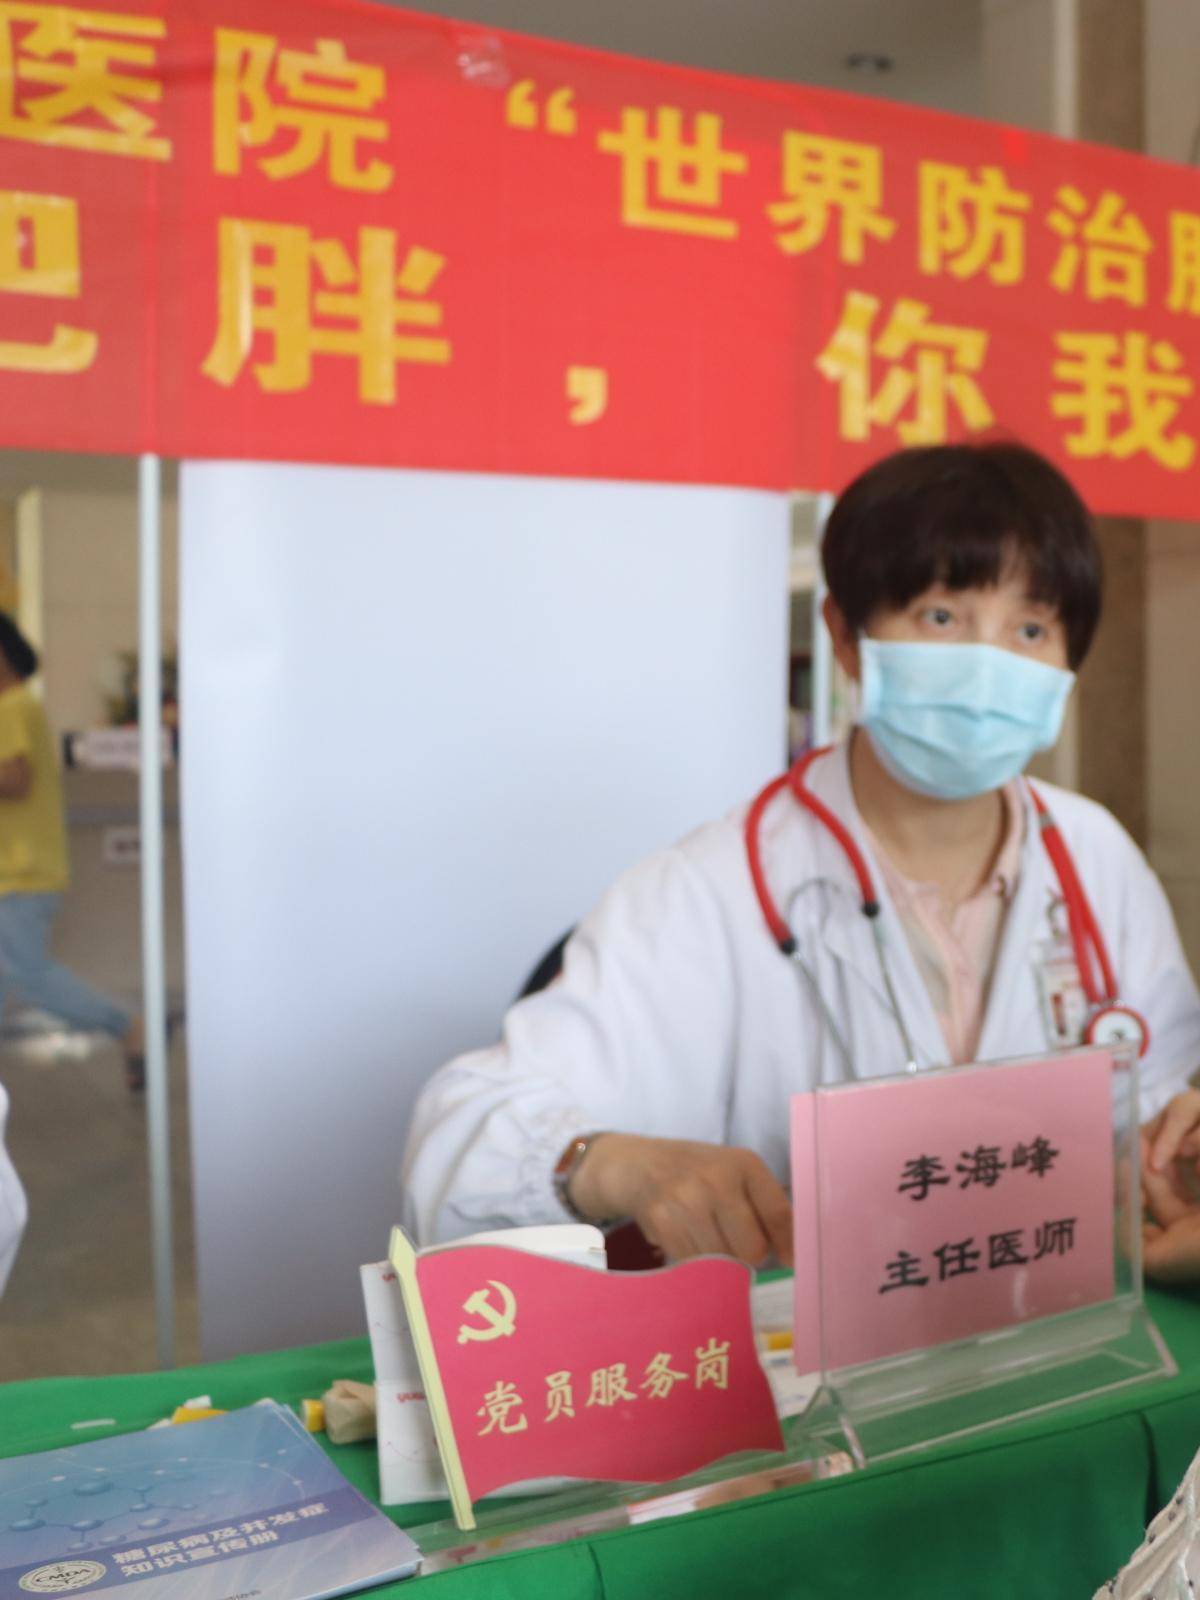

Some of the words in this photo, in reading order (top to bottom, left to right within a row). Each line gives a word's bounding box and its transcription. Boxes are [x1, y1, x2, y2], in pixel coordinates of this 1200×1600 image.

[898, 1135, 1060, 1201] 李海峰
[878, 1217, 1077, 1295] 主任医师
[477, 1338, 732, 1437] 党员服务岗
